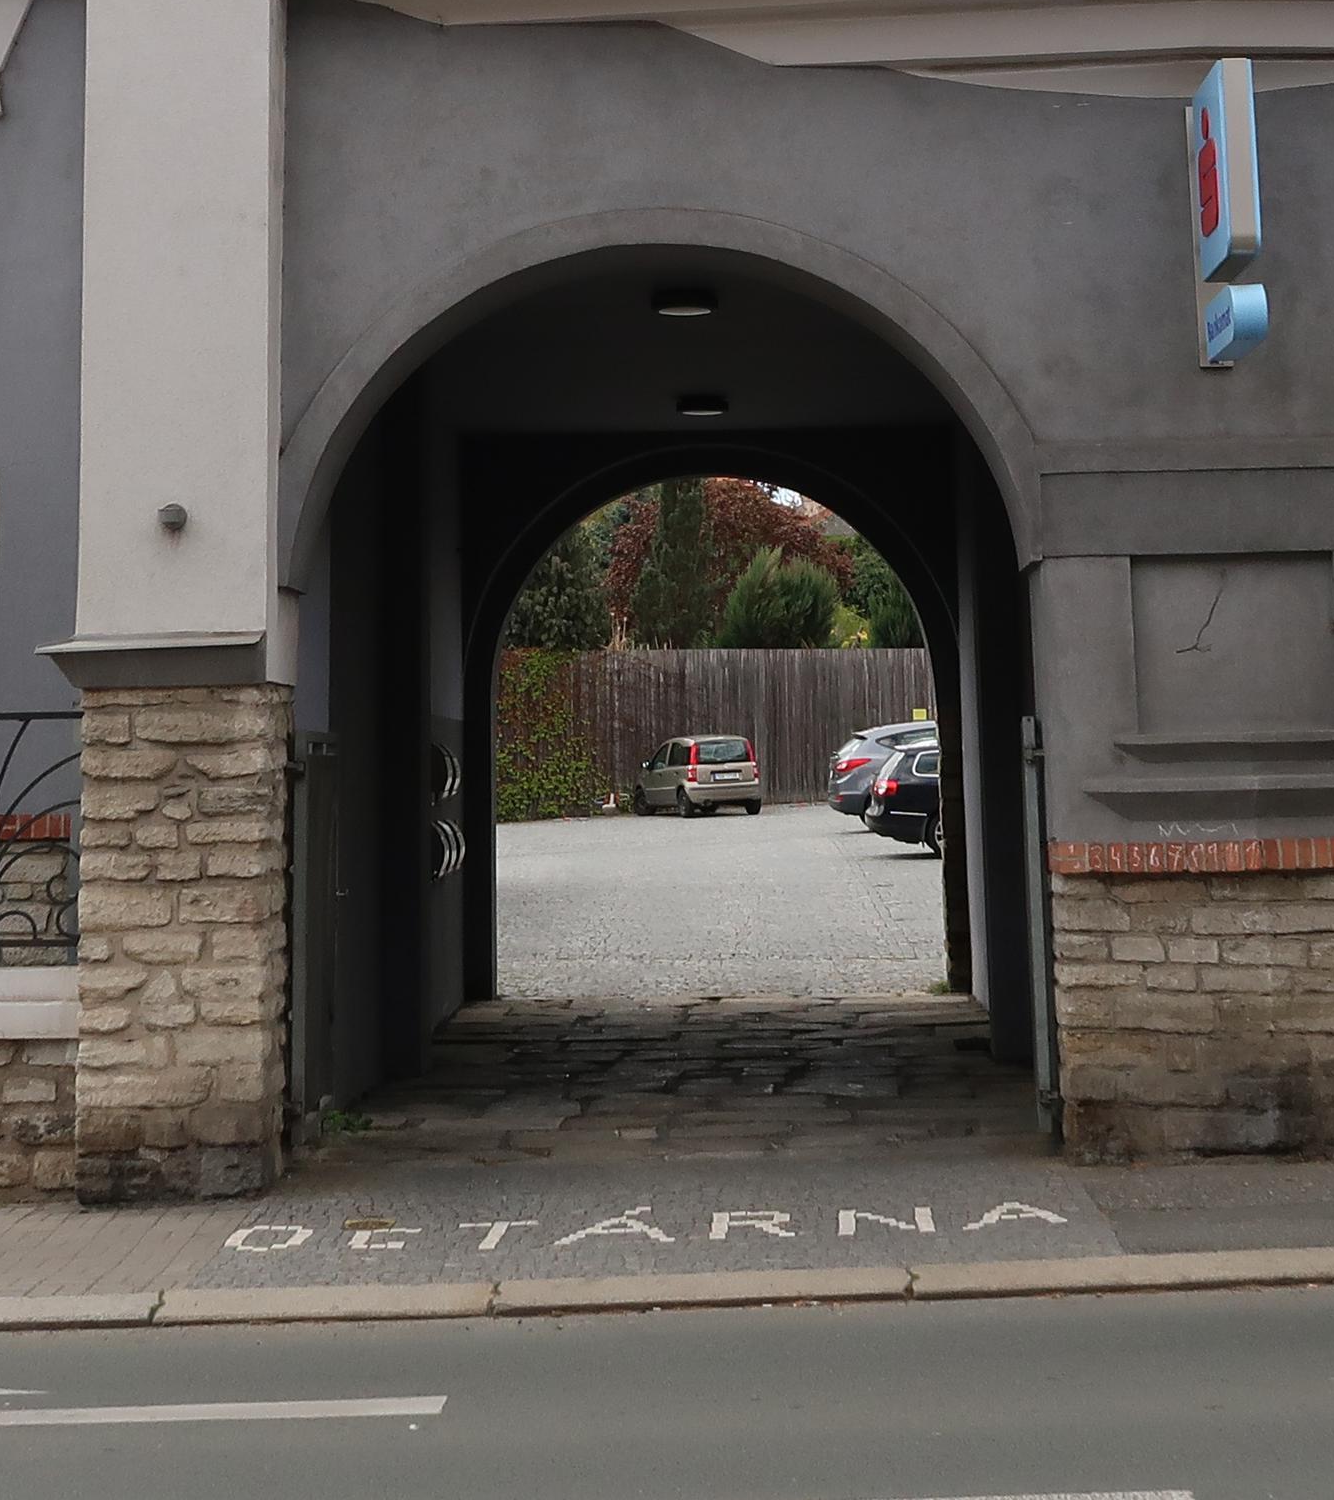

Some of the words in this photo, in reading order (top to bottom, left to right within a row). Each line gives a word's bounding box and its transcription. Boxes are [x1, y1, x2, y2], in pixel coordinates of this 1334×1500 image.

[1111, 846, 1122, 869] 4
[1150, 845, 1160, 867] 6
[1168, 844, 1183, 871] 7
